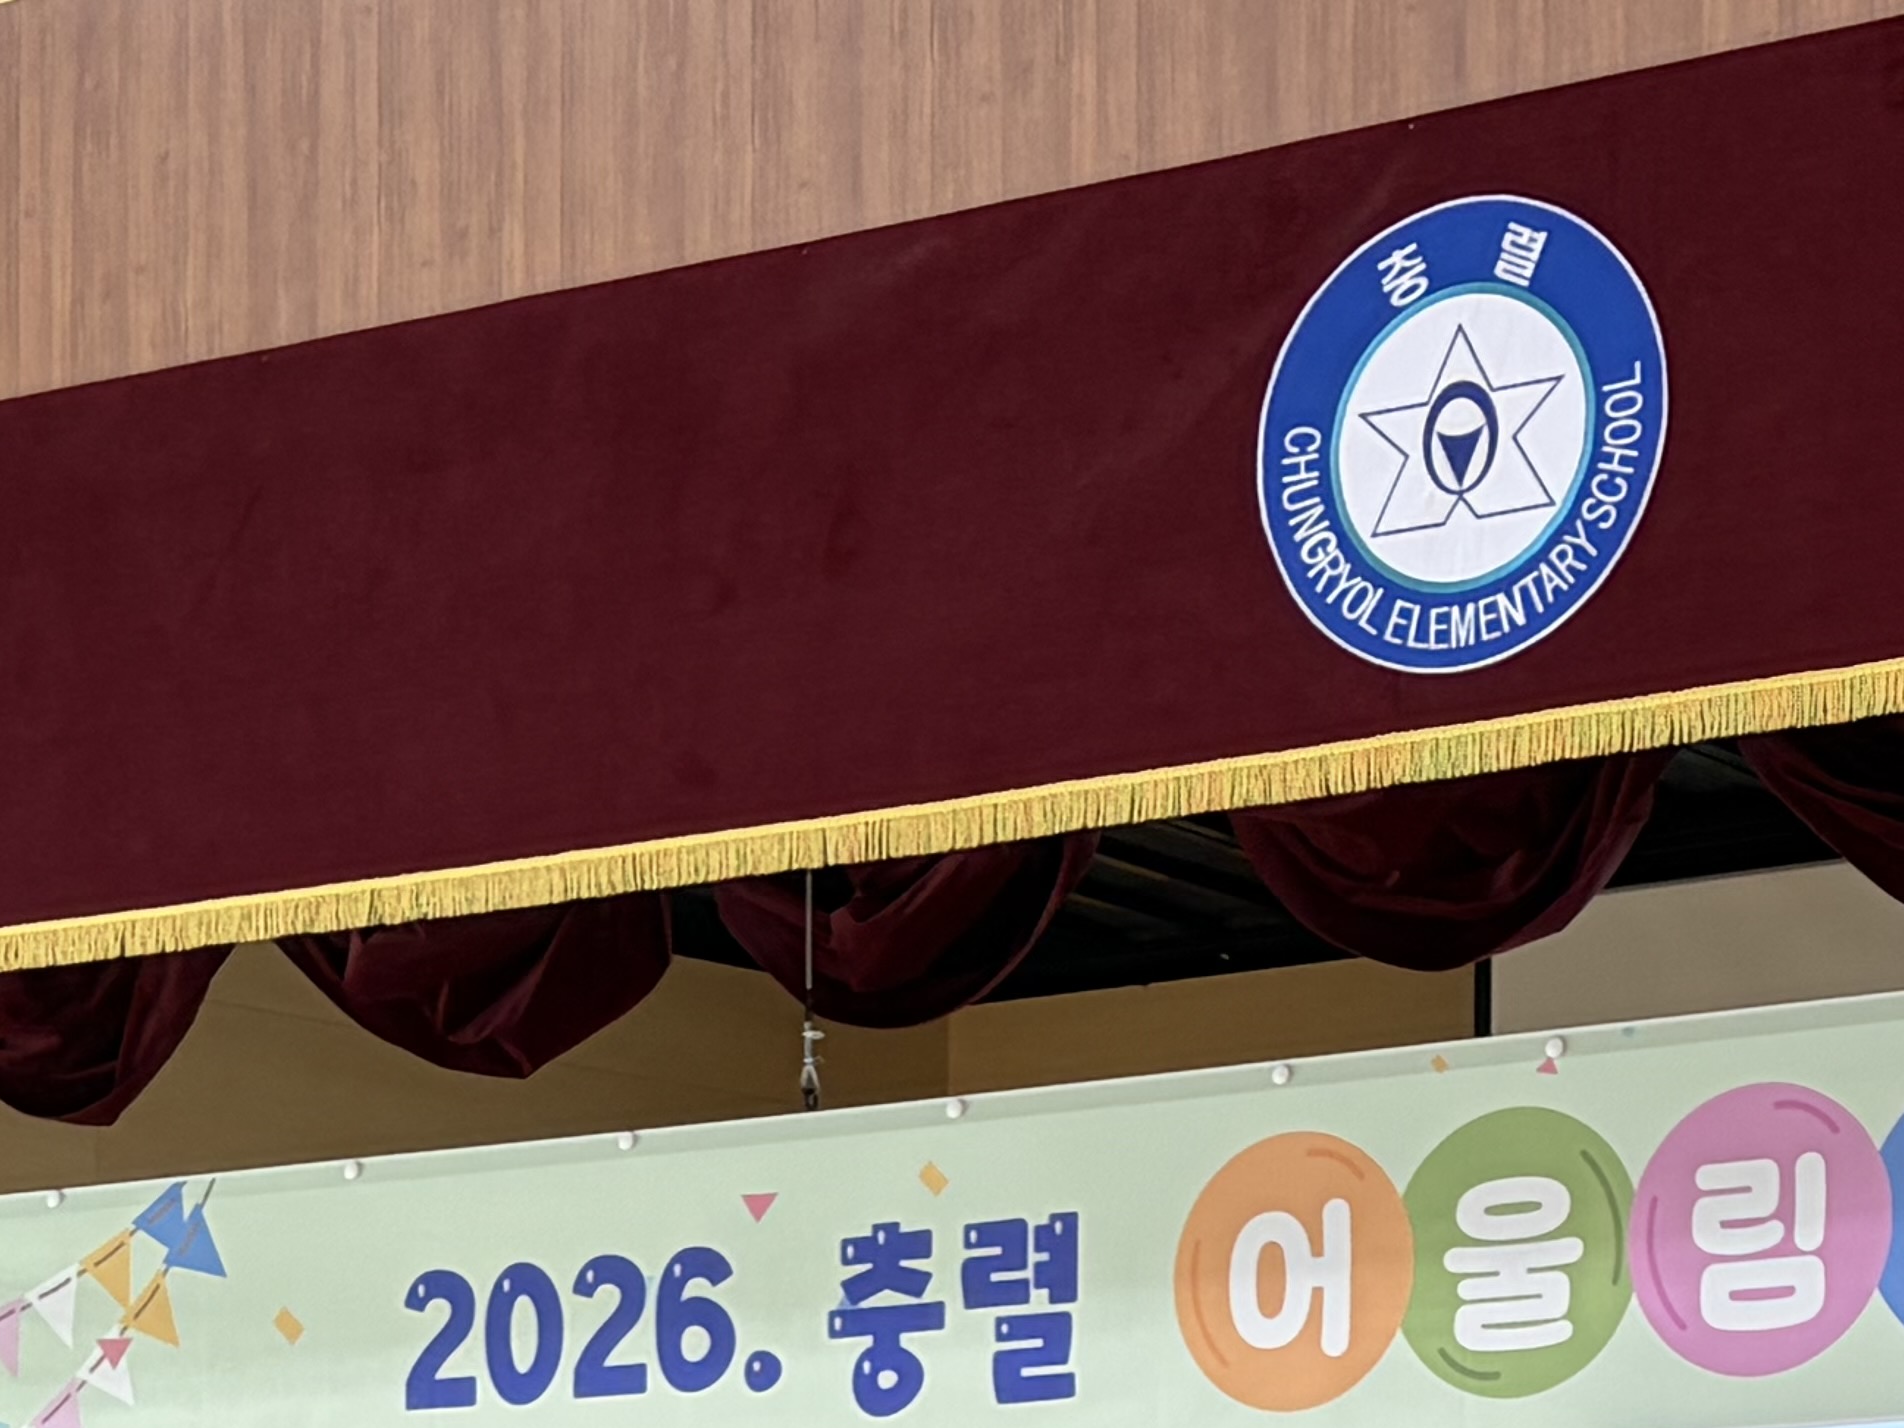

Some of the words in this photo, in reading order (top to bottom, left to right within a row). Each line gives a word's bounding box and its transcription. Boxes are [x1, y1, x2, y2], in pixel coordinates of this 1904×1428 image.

[1279, 426, 1386, 637] CHUNGRYOL
[1383, 519, 1599, 651] ELEMENTARY
[1584, 359, 1646, 531] SCHOOL
[403, 1246, 783, 1413] 2026.
[827, 1212, 1080, 1418] 충렬
